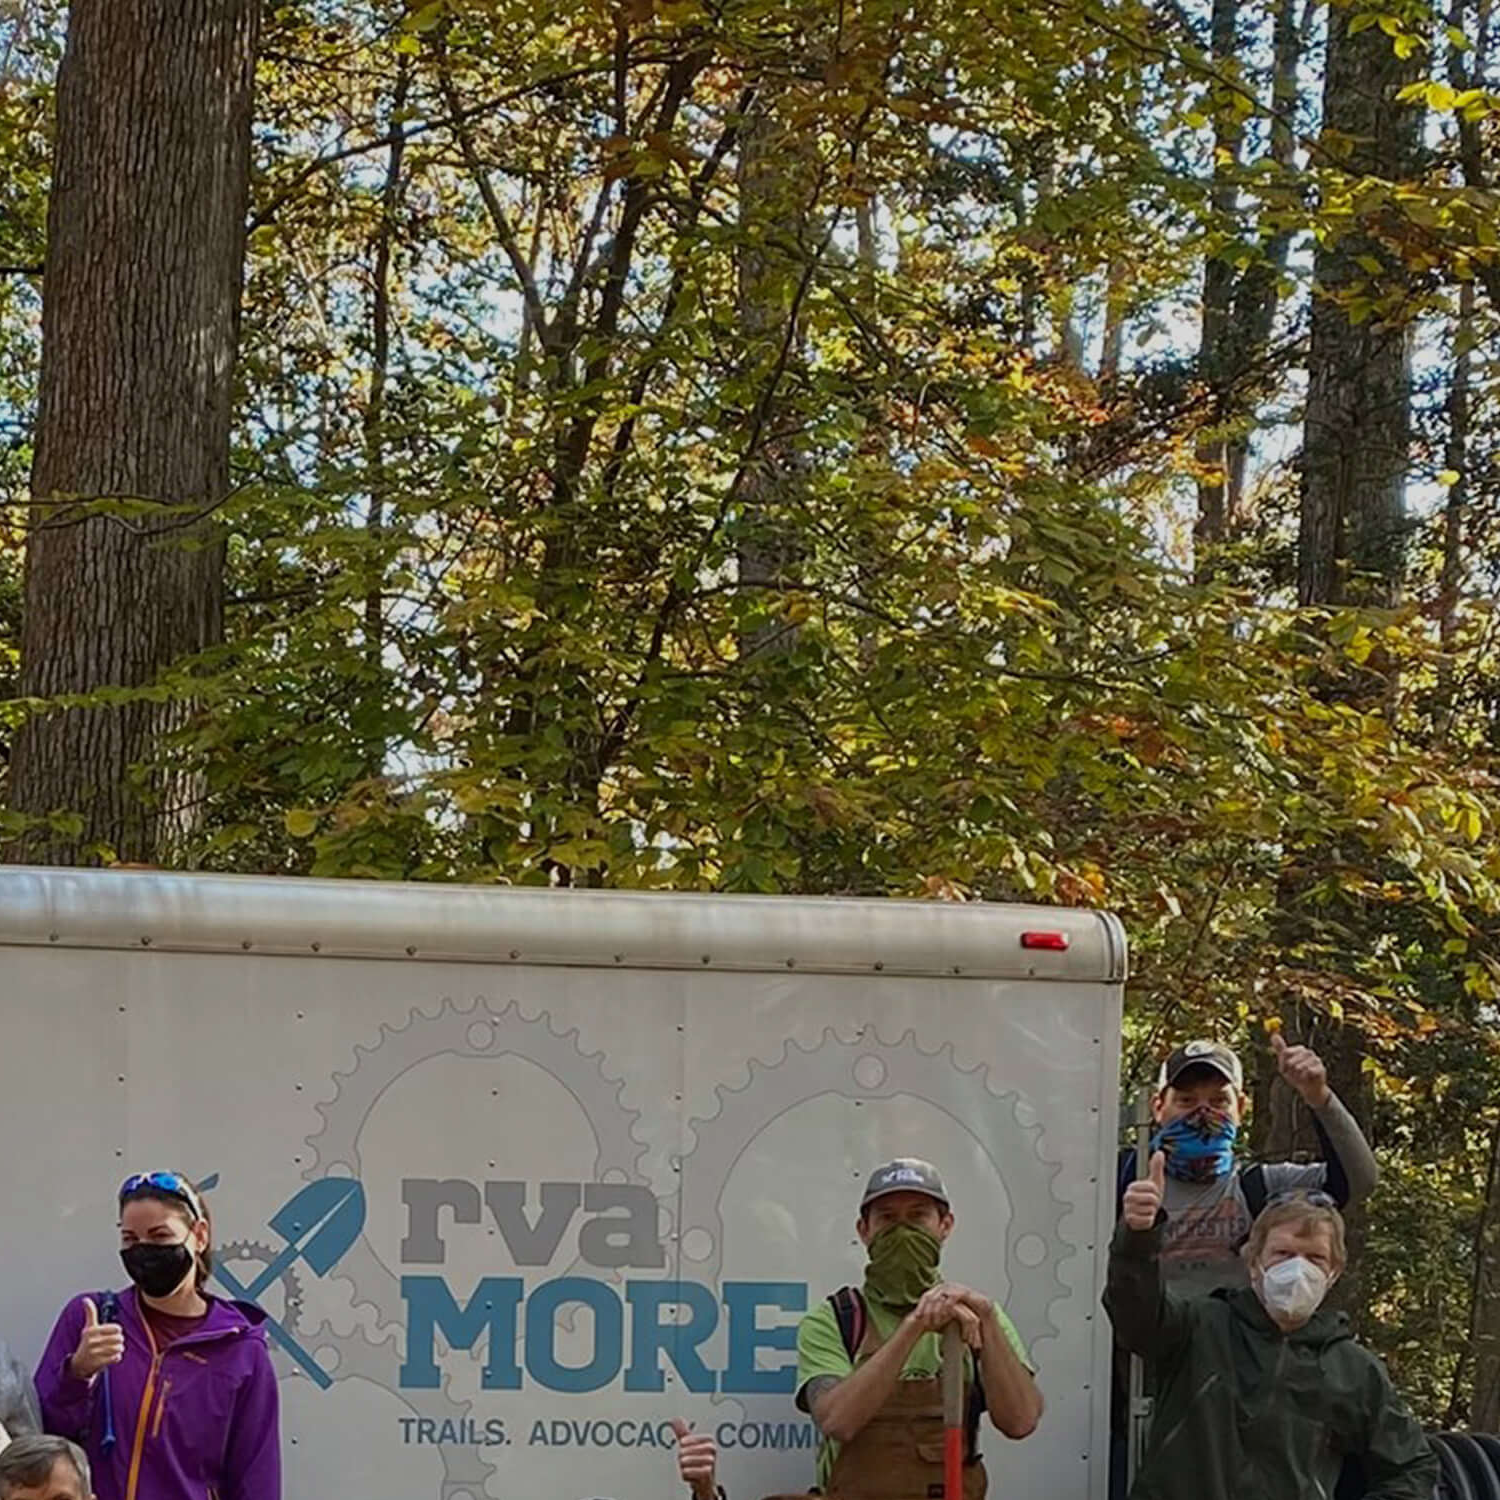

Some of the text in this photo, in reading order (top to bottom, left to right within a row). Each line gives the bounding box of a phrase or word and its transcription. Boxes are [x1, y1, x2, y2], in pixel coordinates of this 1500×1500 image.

[401, 1179, 666, 1268] rva
[398, 1276, 808, 1394] MORE
[398, 1418, 512, 1446] TRAILS.
[528, 1420, 696, 1449] ADVOCAC
